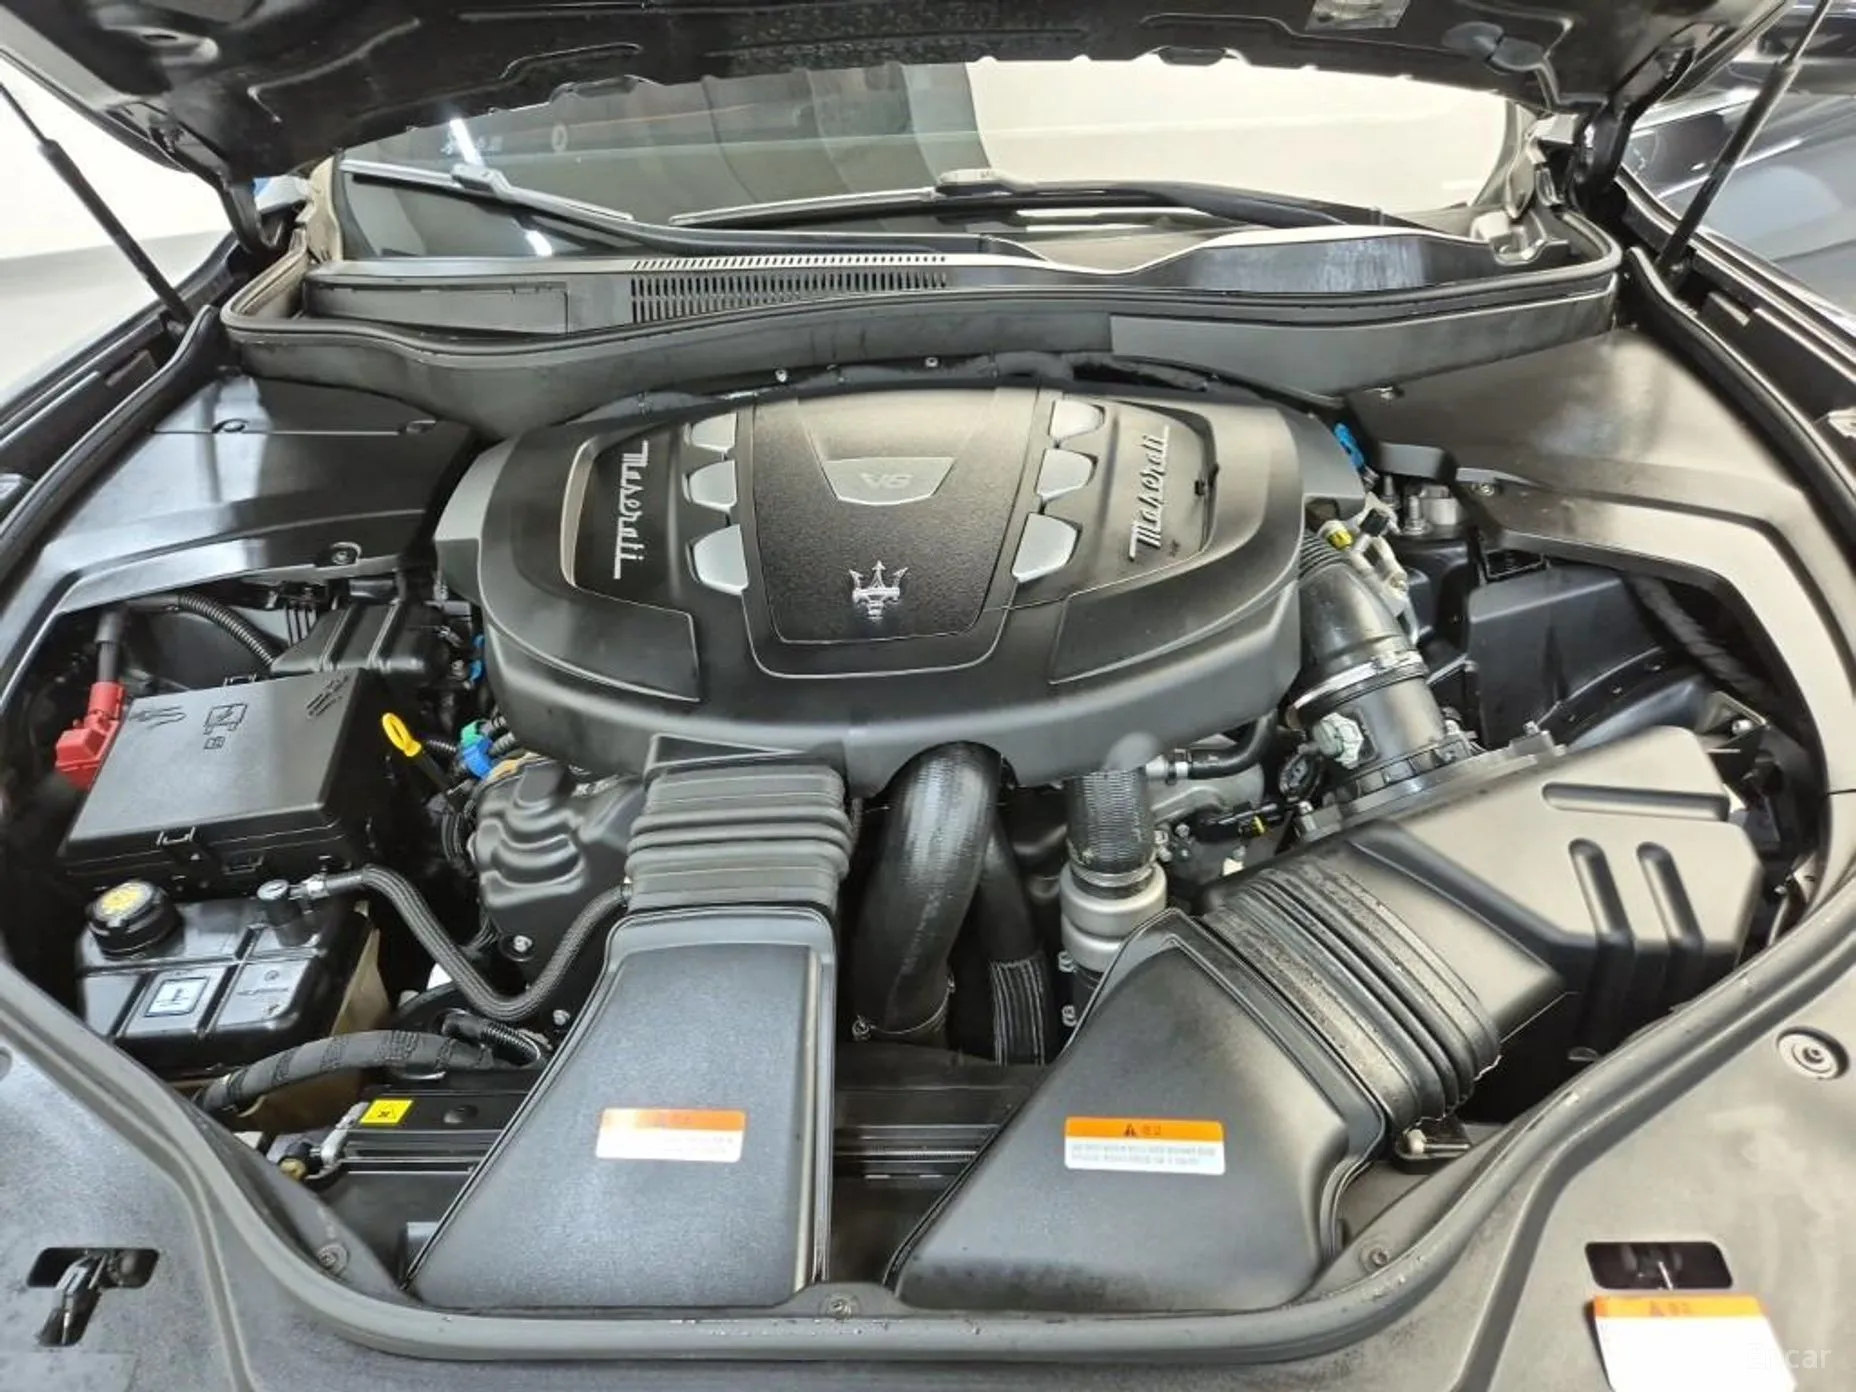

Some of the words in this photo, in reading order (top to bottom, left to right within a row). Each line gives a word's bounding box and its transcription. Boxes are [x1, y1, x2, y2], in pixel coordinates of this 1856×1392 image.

[613, 440, 649, 580] Maserati
[860, 472, 915, 490] V6
[1128, 424, 1170, 562] Maserati
